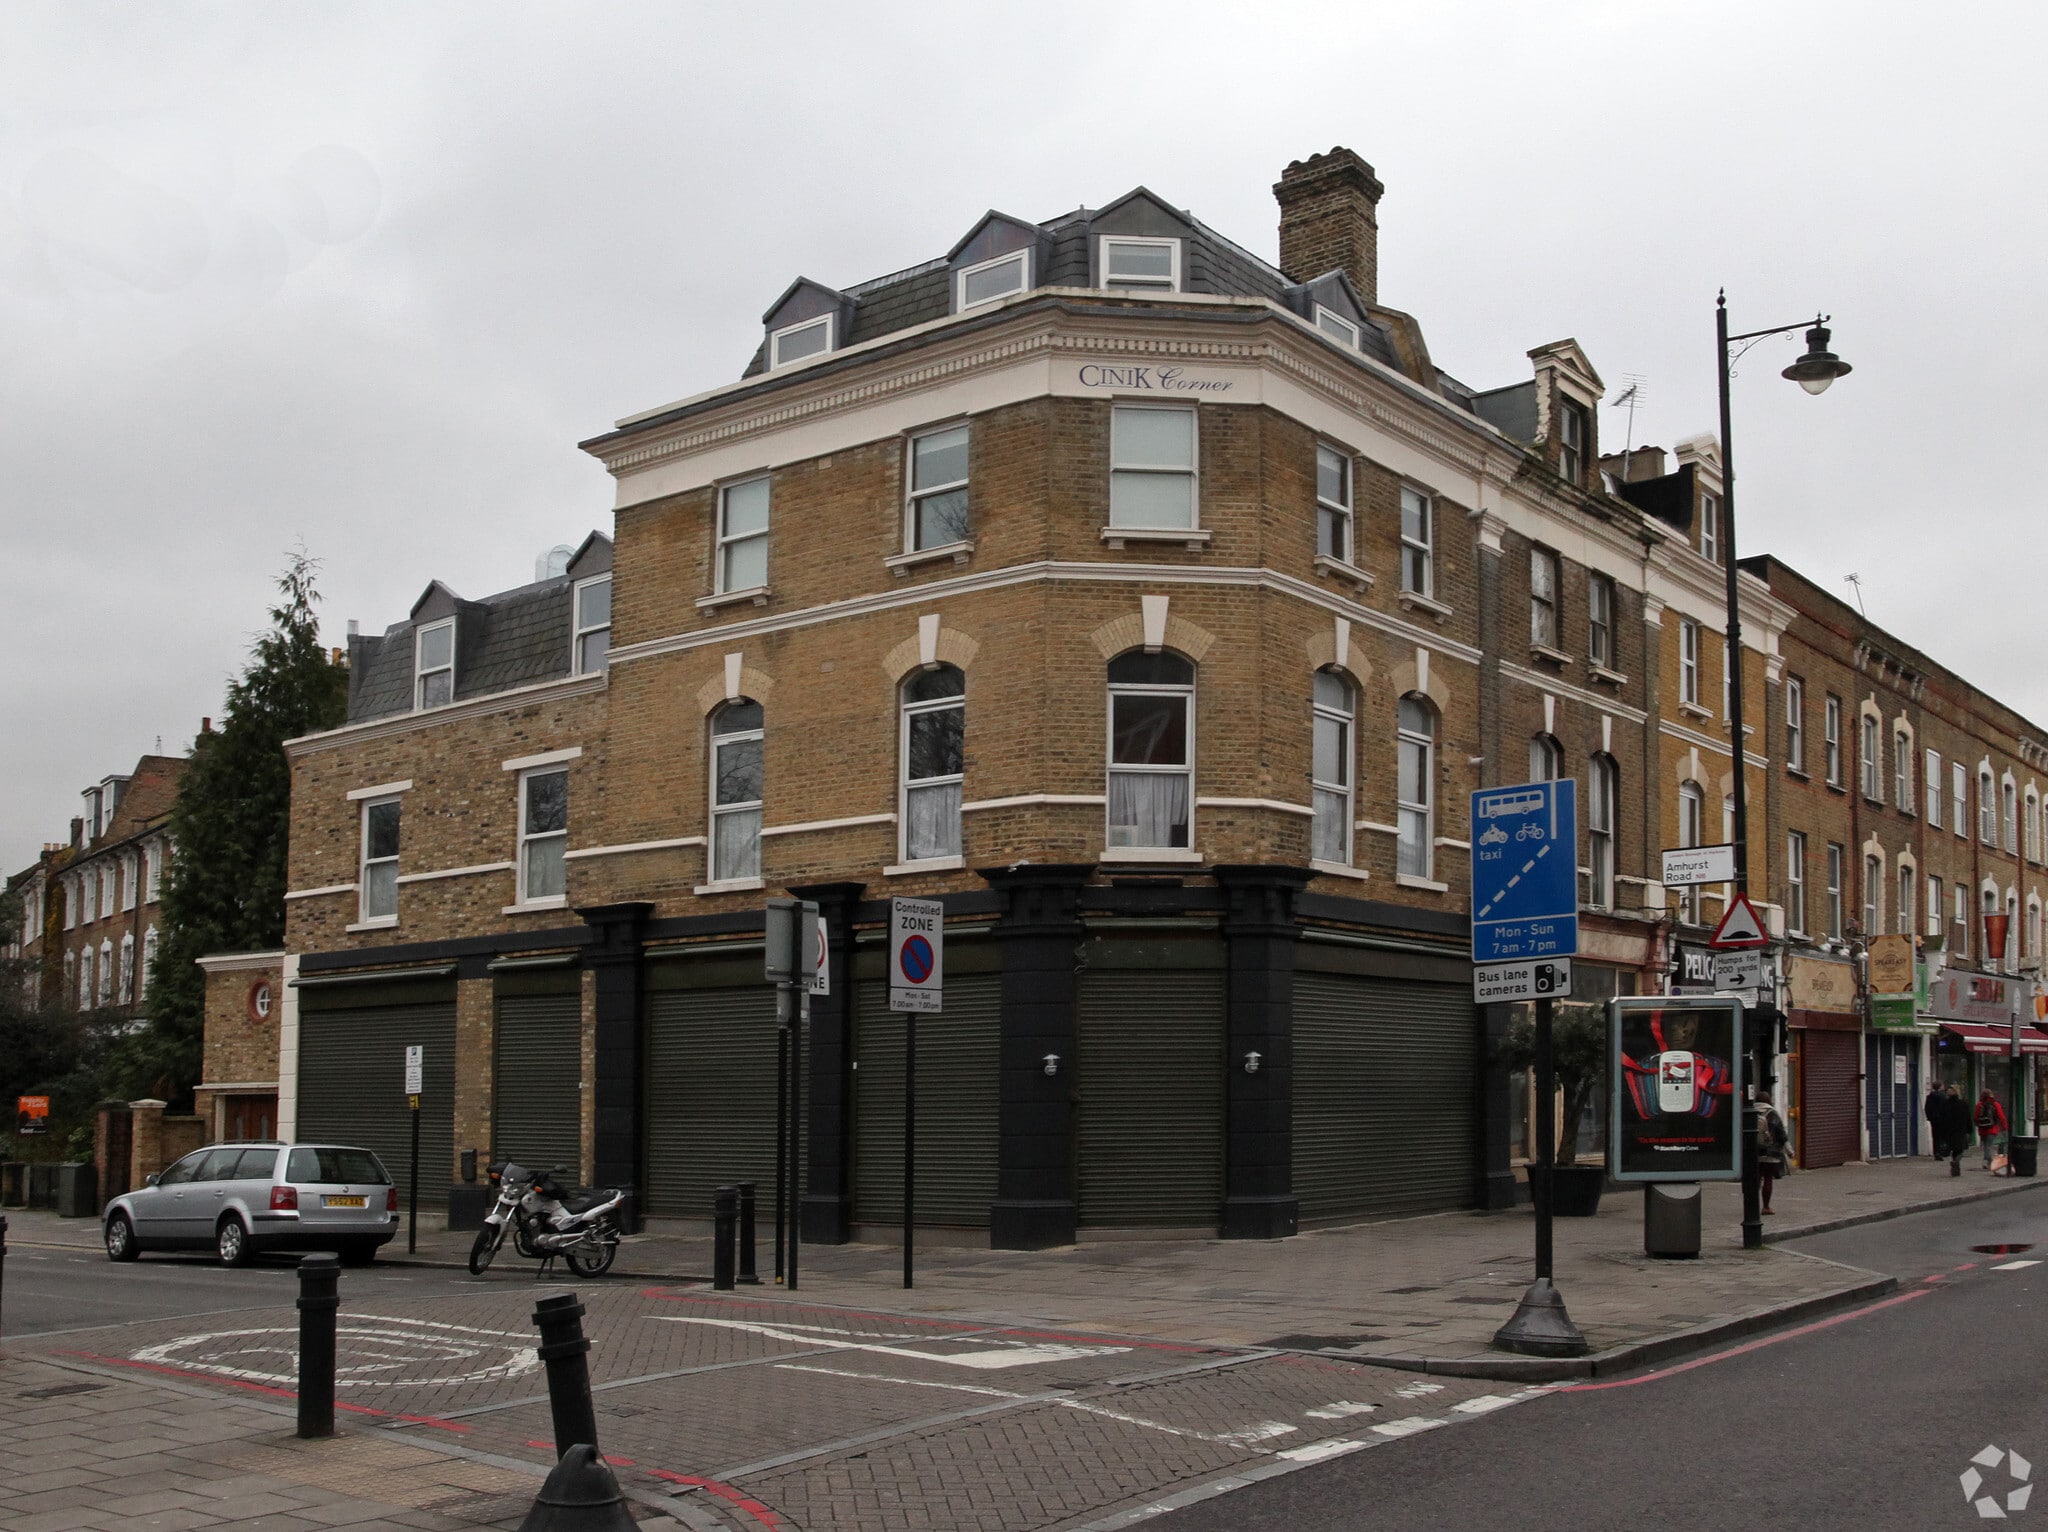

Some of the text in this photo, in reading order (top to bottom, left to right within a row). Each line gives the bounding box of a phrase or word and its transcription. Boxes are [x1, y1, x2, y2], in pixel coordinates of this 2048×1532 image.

[1079, 364, 1233, 391] CINIK Corner
[1480, 848, 1502, 861] taxi
[1666, 860, 1709, 872] Amhurst
[1666, 872, 1692, 882] Road
[895, 901, 941, 916] Controlled
[901, 916, 934, 931] ZONE
[1494, 927, 1521, 938] Mon
[1530, 924, 1554, 936] Sun
[1717, 954, 1758, 967] Humps for
[1717, 964, 1758, 974] 200 yards
[1478, 970, 1528, 983] Bus lane
[1478, 984, 1528, 996] cameras
